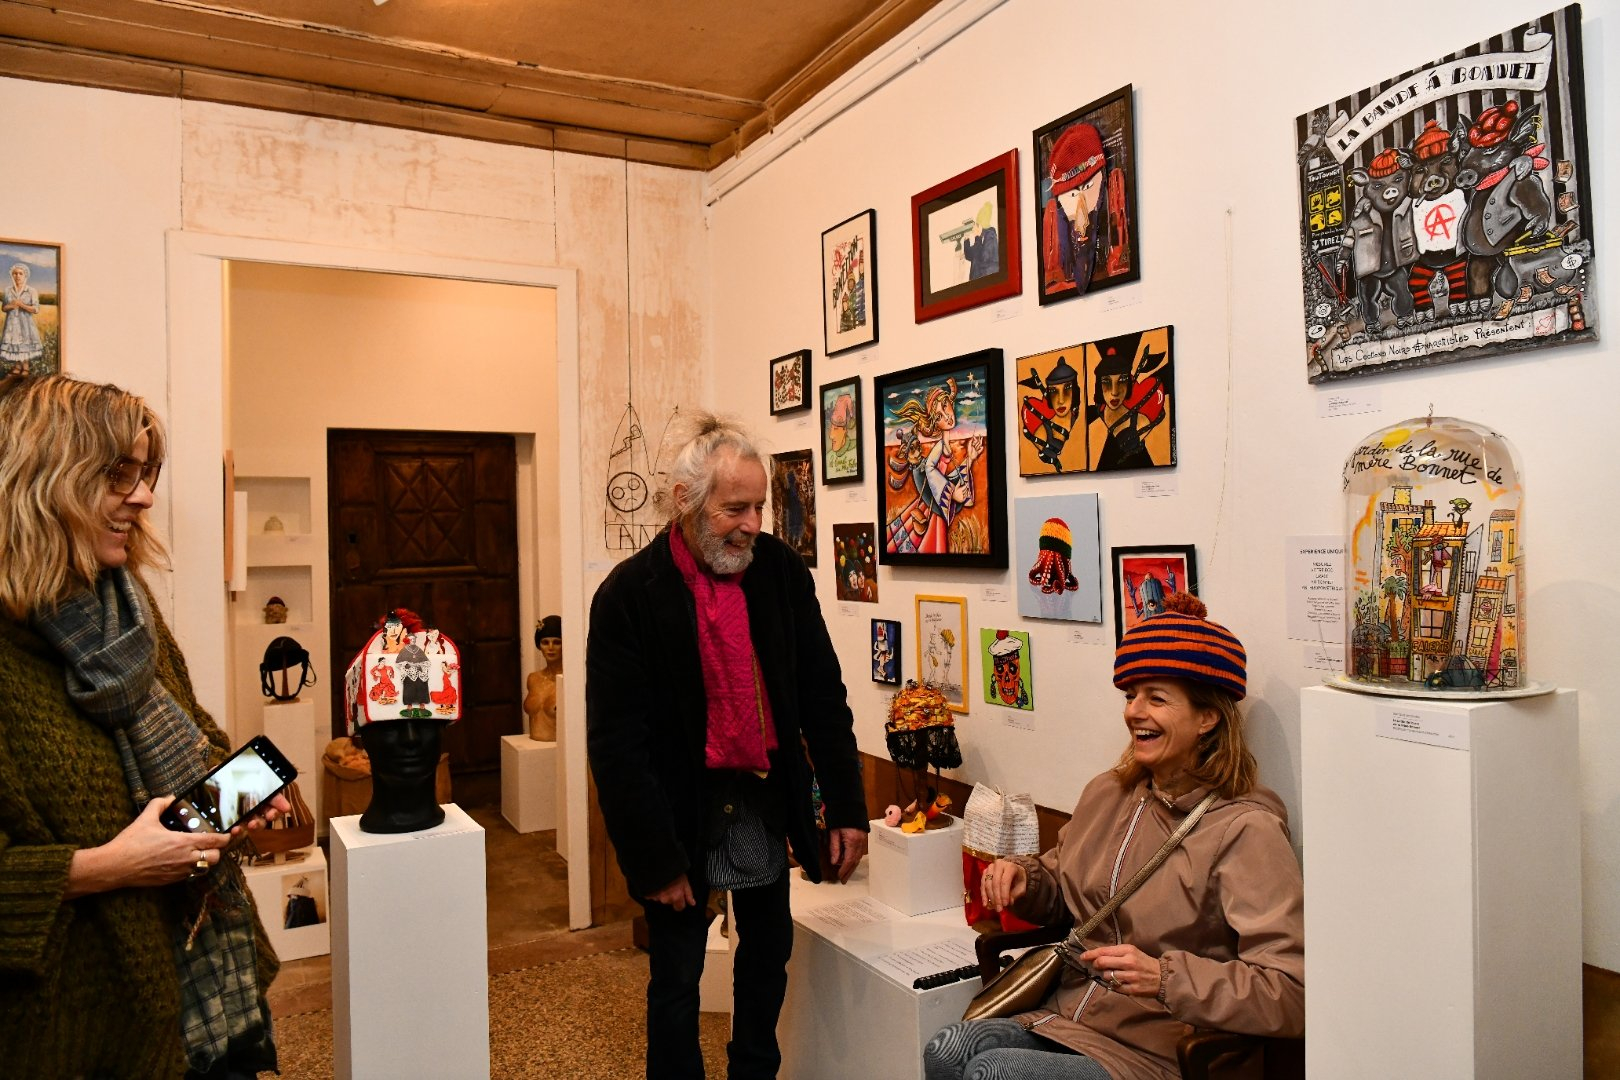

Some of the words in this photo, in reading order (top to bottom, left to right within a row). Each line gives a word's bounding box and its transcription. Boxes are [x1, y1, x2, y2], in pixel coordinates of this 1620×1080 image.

[1336, 126, 1360, 152] LA
[1362, 82, 1421, 128] BANDE
[1450, 61, 1545, 85] BONNET
[1396, 439, 1413, 454] de
[1444, 448, 1483, 470] rue
[1487, 467, 1505, 486] de
[1399, 454, 1478, 486] Bonnet
